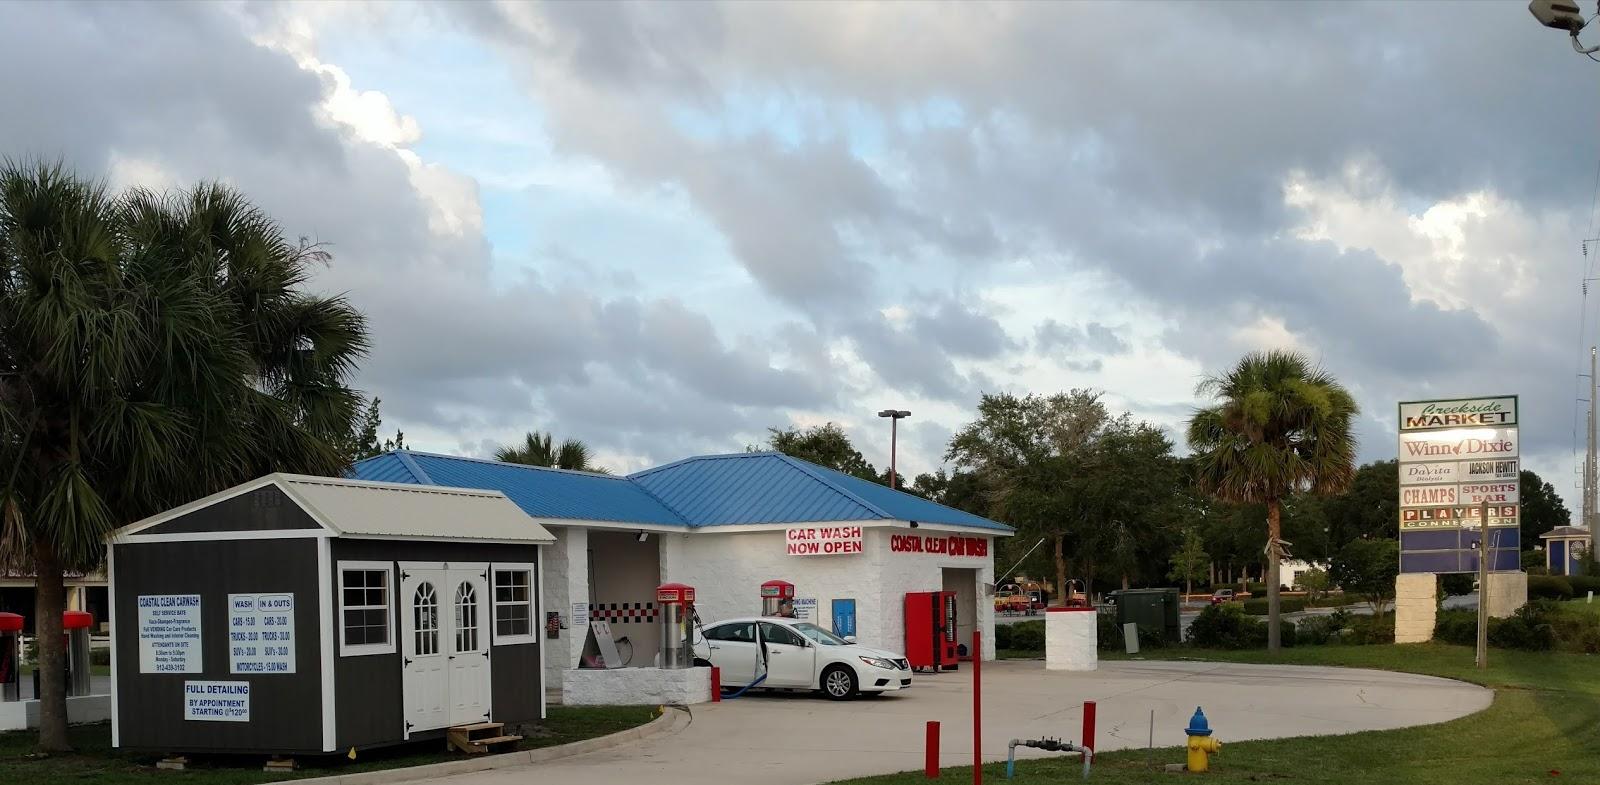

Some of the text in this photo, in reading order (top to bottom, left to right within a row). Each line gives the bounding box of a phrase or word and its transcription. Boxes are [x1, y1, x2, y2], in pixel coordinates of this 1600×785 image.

[1422, 401, 1501, 416] Creekside
[1406, 412, 1511, 427] MARKET
[1404, 438, 1513, 456] Winn Dixie
[1408, 464, 1452, 476] DaVita
[1469, 461, 1516, 475] JACKSON HEWITT
[1462, 484, 1516, 494] SPORTS
[1404, 488, 1455, 504] CHAMPS
[1472, 494, 1506, 503] BAR
[1406, 507, 1513, 520] PLAYERS
[788, 527, 861, 541] CAR WASH
[787, 541, 862, 554] NOW OPEN
[890, 534, 988, 557] COASTAL CLEAN CAR WASH
[140, 596, 200, 607] COASTAL CLEAN CARWASH
[235, 600, 253, 608] WASH
[233, 617, 243, 626] CARS
[264, 617, 274, 626] CARS
[231, 632, 245, 641] TRUCKS
[262, 632, 277, 641] TRUCKS
[236, 662, 263, 671] MOTORCYCLES
[277, 662, 288, 671] WASH
[186, 685, 248, 694] FULL DETAILING
[192, 708, 223, 716] STARTING
